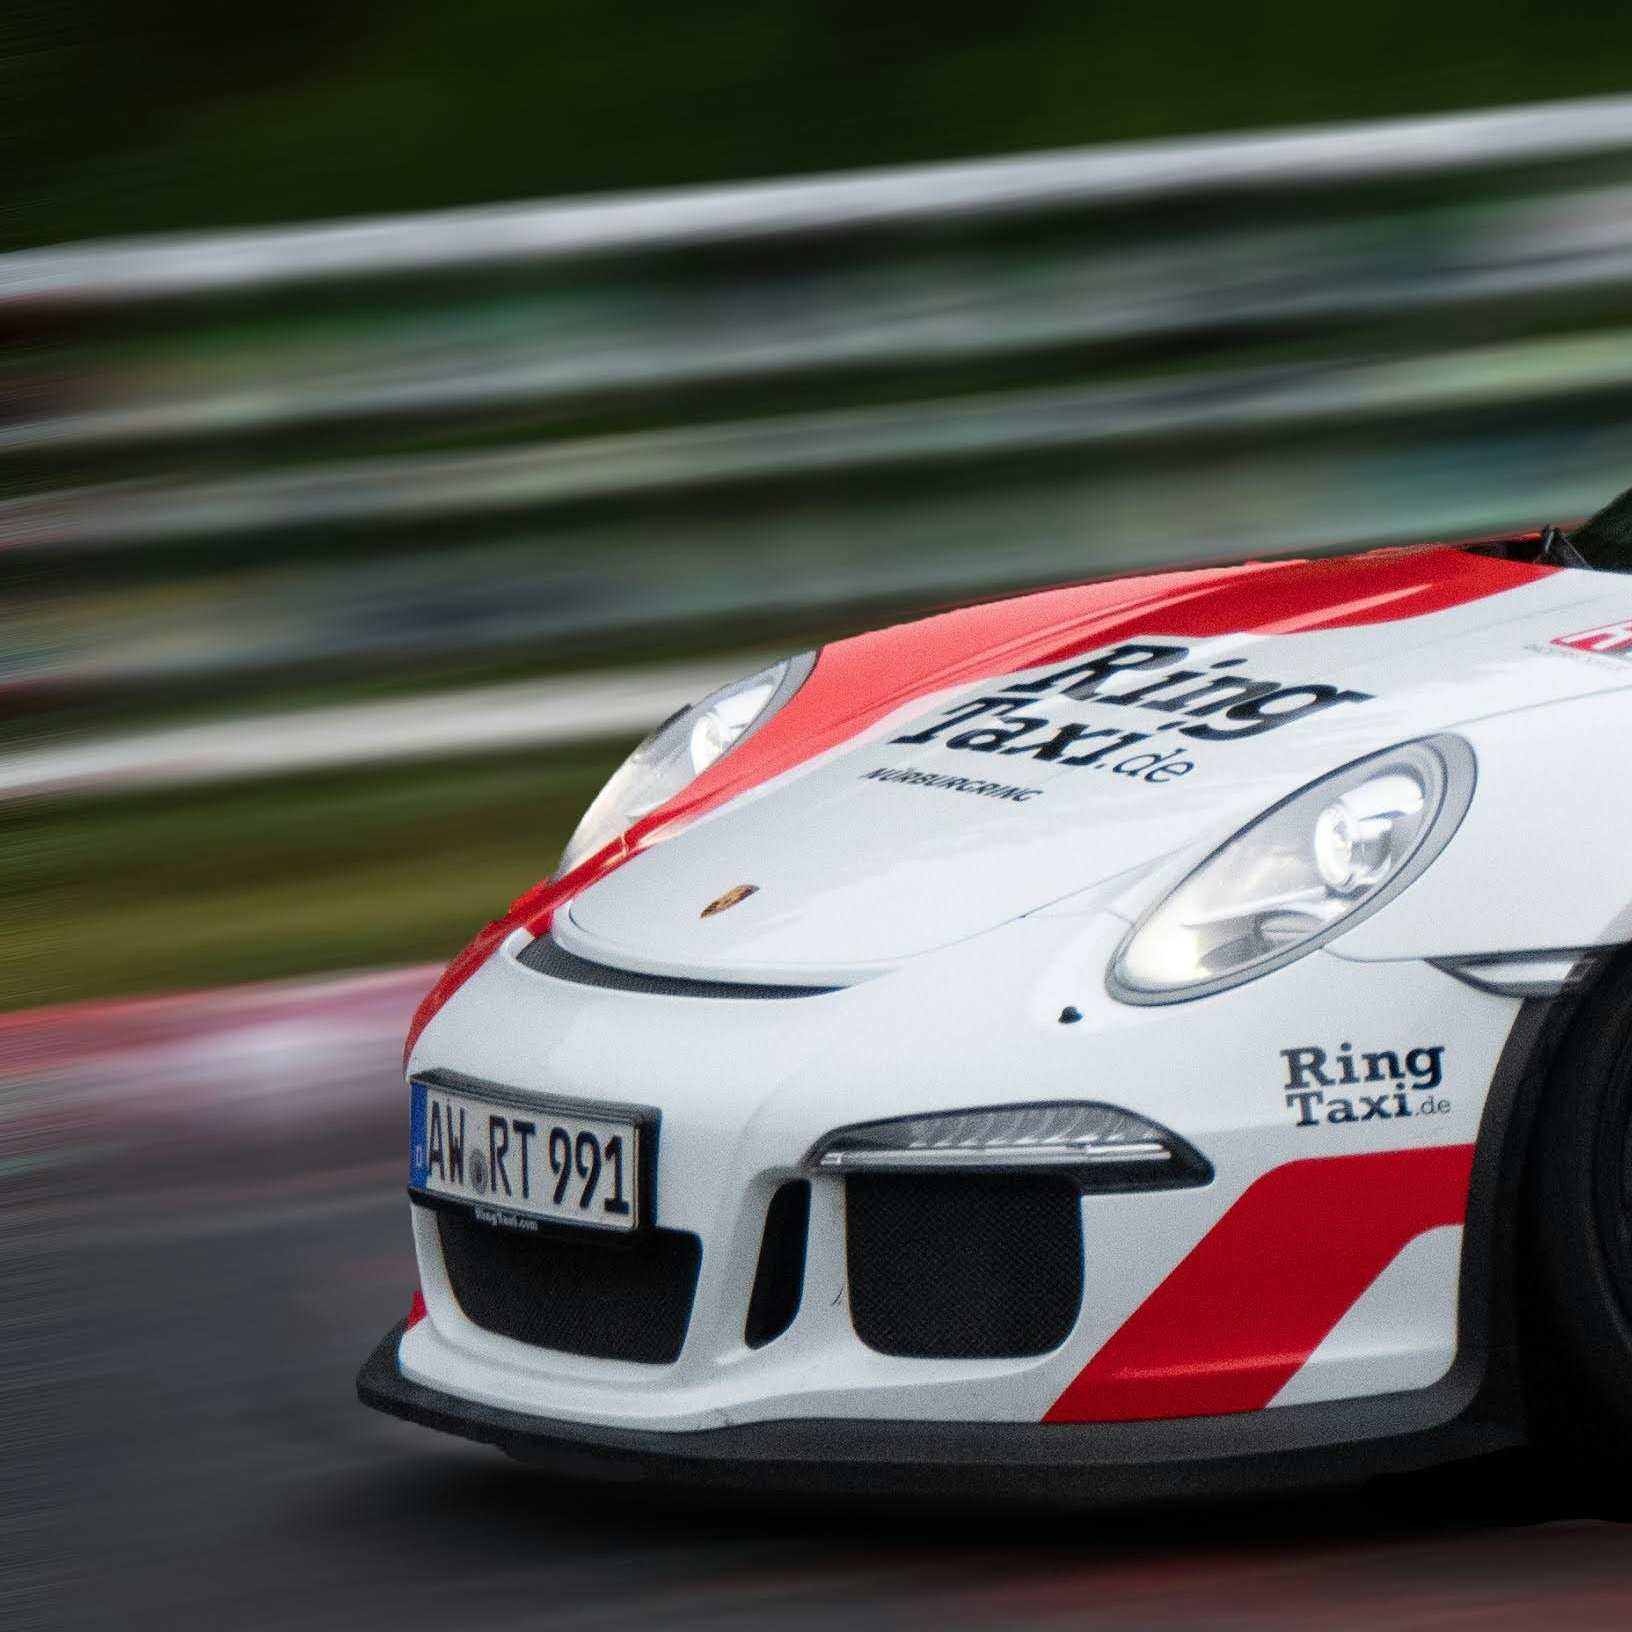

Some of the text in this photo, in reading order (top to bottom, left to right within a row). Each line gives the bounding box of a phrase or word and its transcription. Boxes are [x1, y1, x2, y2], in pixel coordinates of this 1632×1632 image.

[1000, 643, 1377, 742] Ring
[1279, 1040, 1445, 1090] Ring
[428, 1100, 630, 1215] AW RT 991
